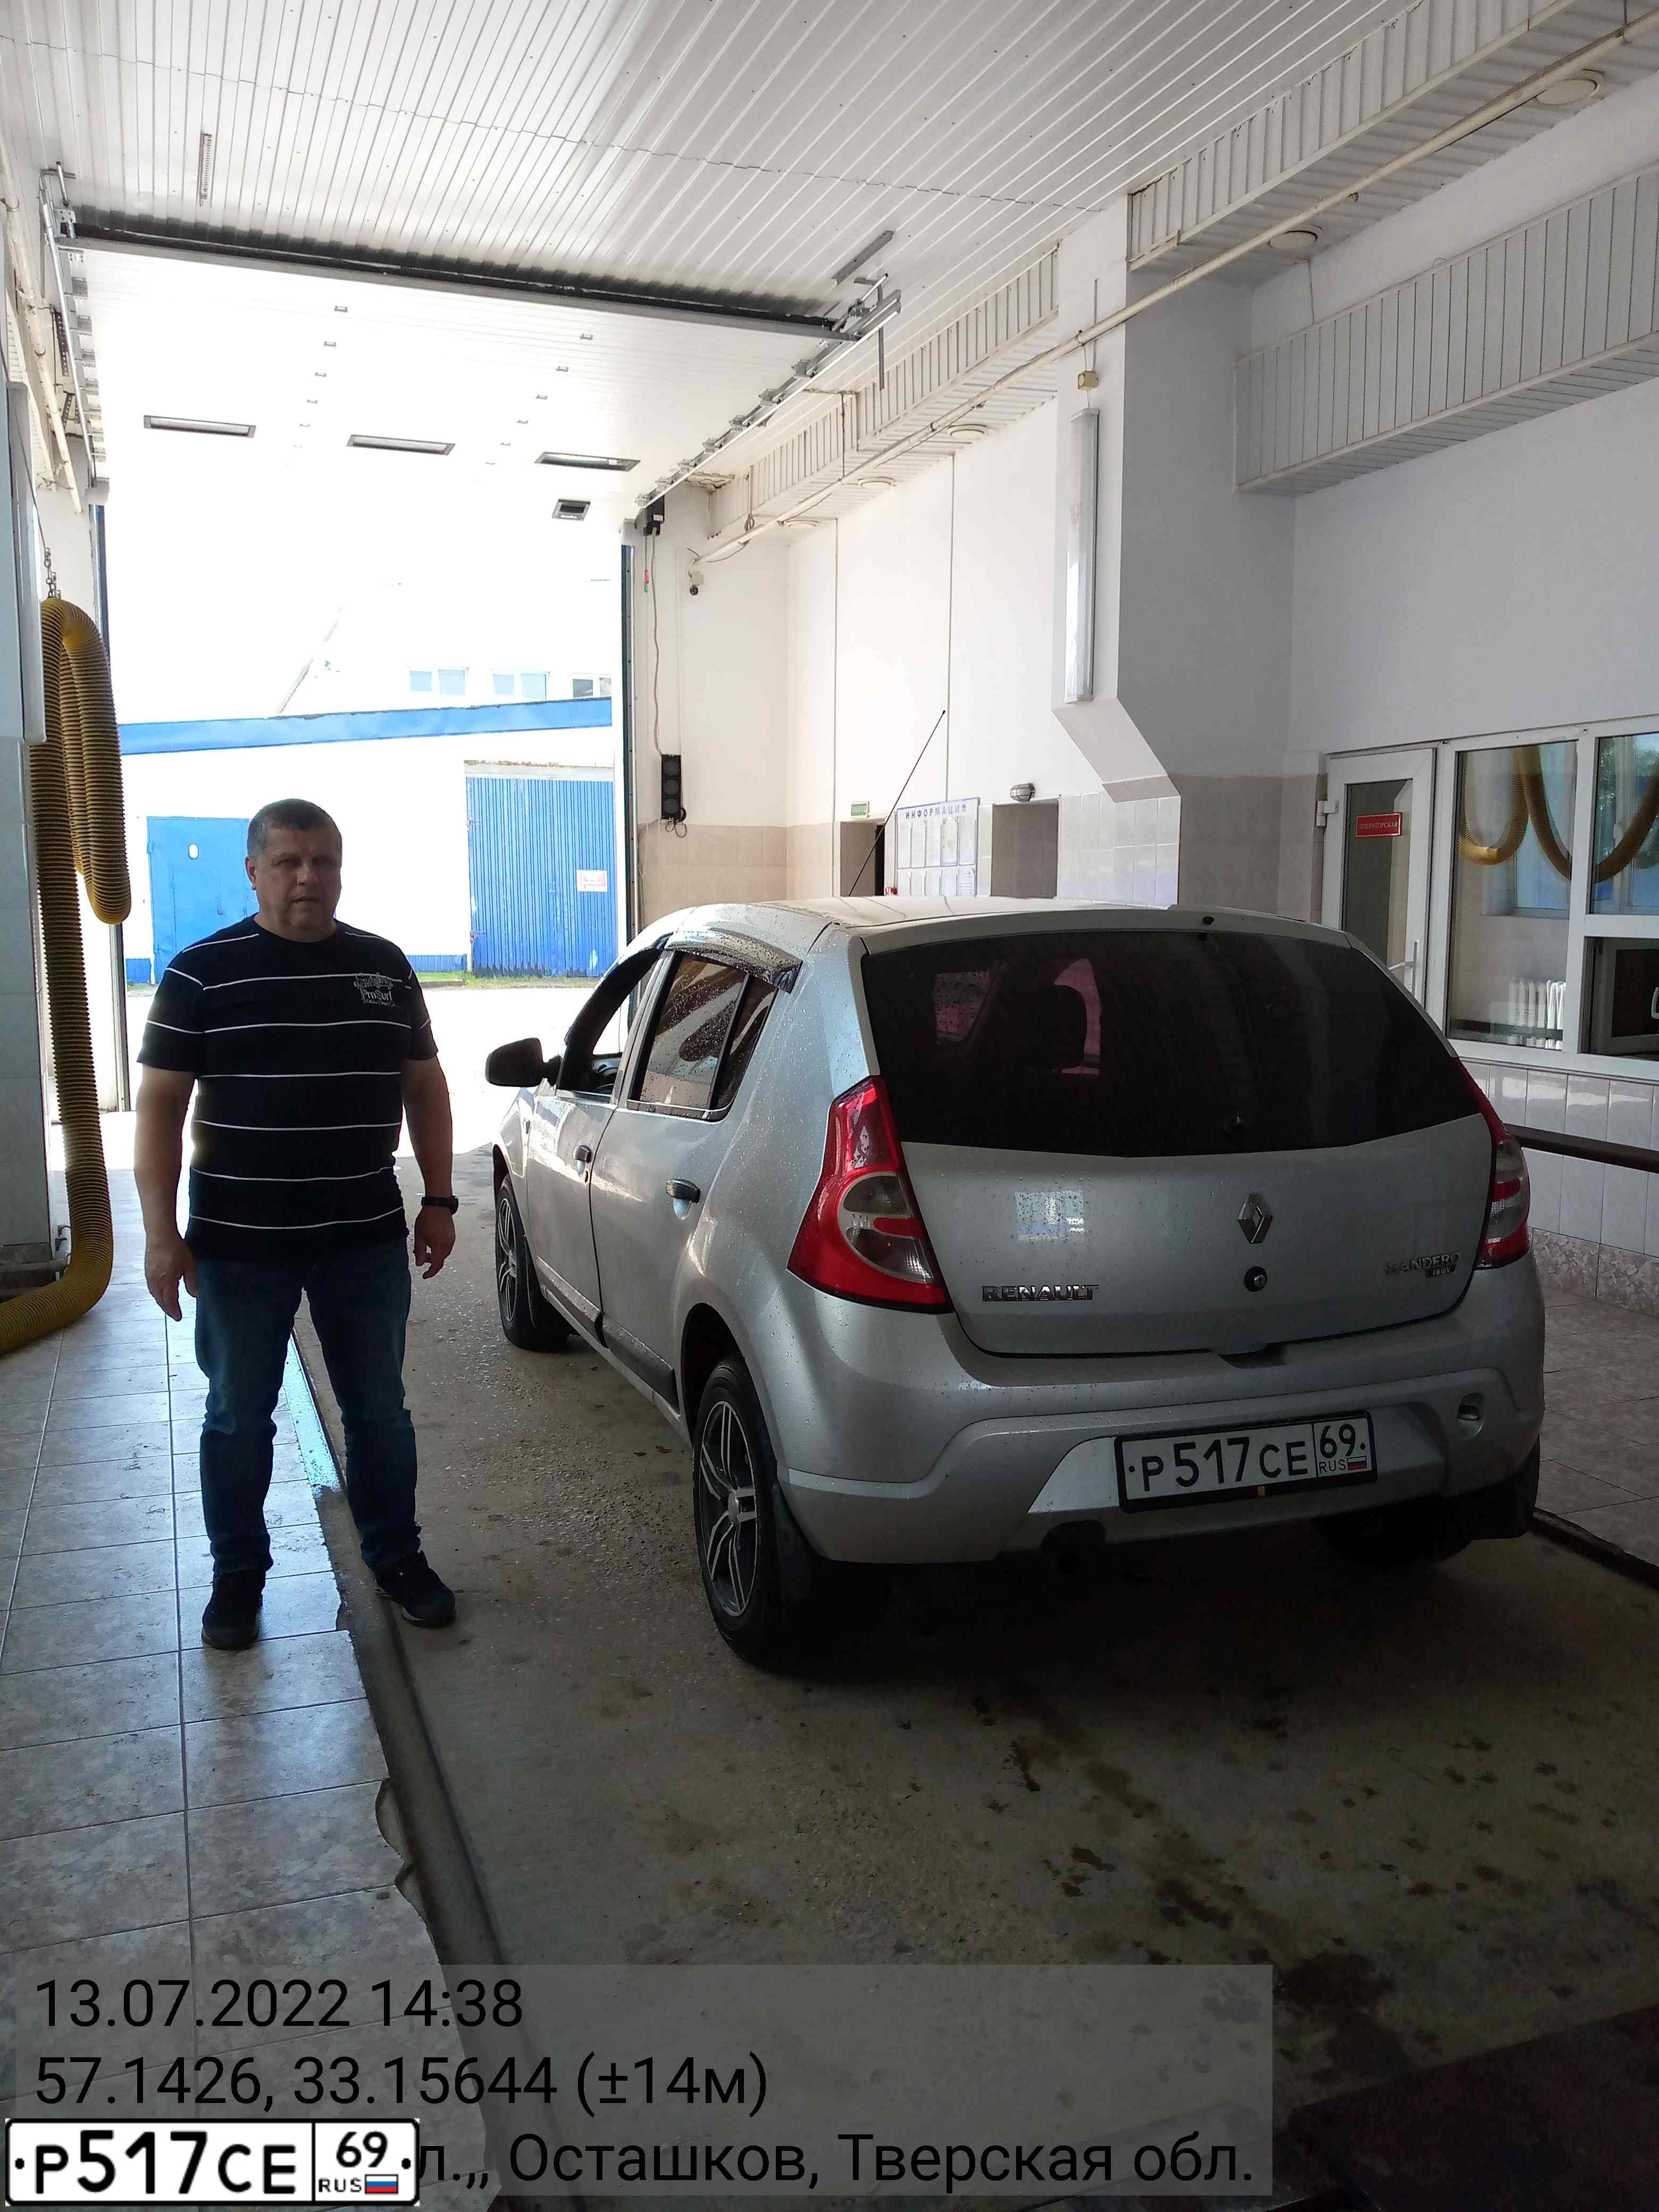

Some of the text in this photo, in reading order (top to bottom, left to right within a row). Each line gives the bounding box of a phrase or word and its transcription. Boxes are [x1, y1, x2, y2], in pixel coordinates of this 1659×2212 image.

[906, 804, 966, 819] ИНФОРМАЦИЯ
[1358, 821, 1398, 830] ОПЕРАТОРСКАЯ
[1385, 1252, 1460, 1275] SANDERO
[982, 1285, 1099, 1302] RENAULT
[1142, 1424, 1356, 1492] Р517СЕ 69
[1319, 1460, 1346, 1473] RUS
